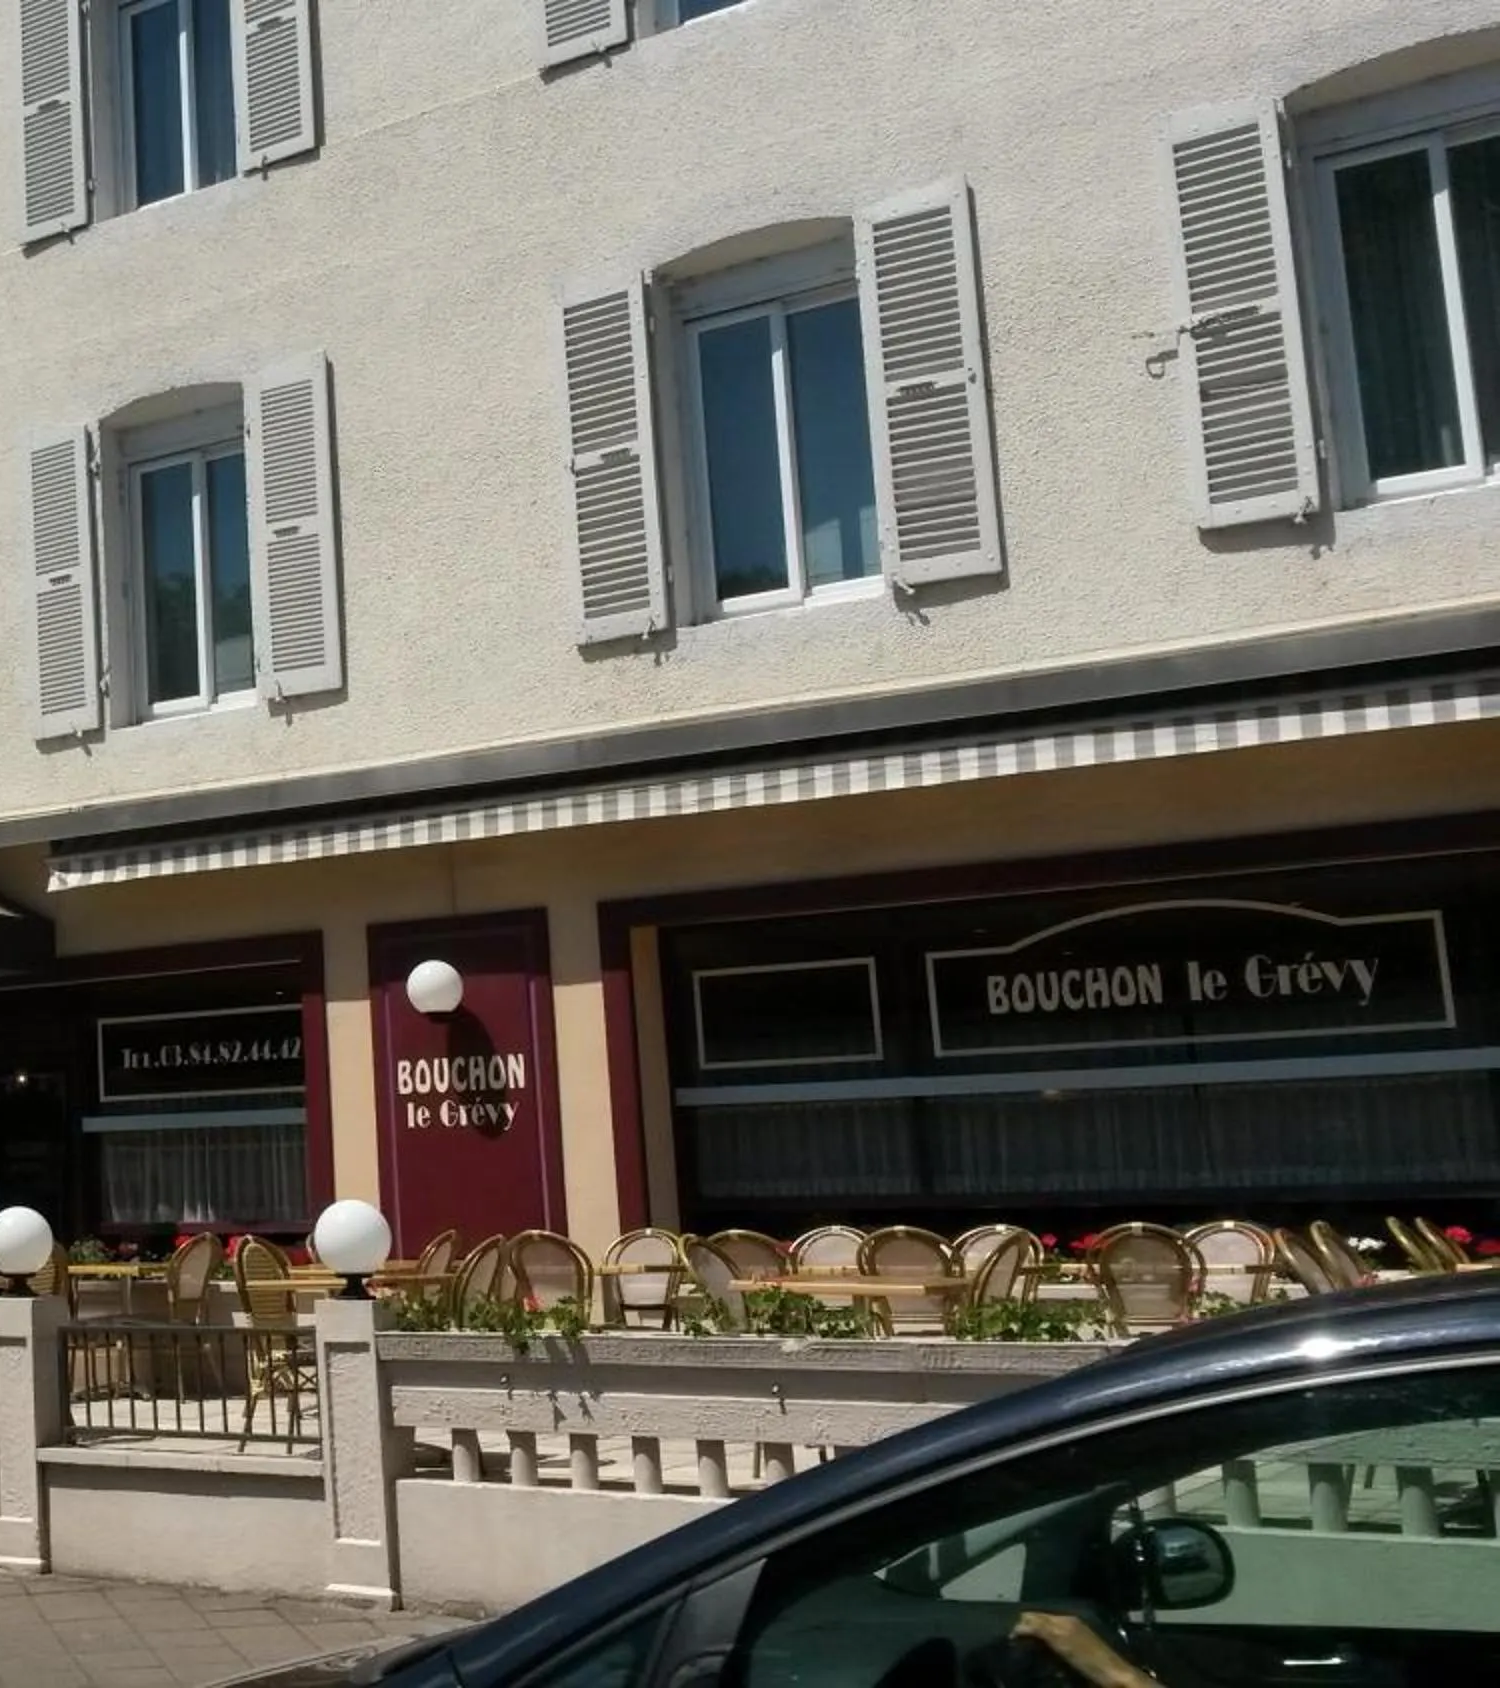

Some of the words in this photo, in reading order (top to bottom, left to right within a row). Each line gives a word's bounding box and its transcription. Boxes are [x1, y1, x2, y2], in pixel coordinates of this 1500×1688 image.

[986, 963, 1163, 1015] BOUCHON
[1186, 960, 1228, 1001] le
[1244, 952, 1379, 1007] Grévy
[397, 1052, 526, 1095] BOUCHON
[406, 1101, 432, 1129] le
[439, 1096, 520, 1131] Grévy
